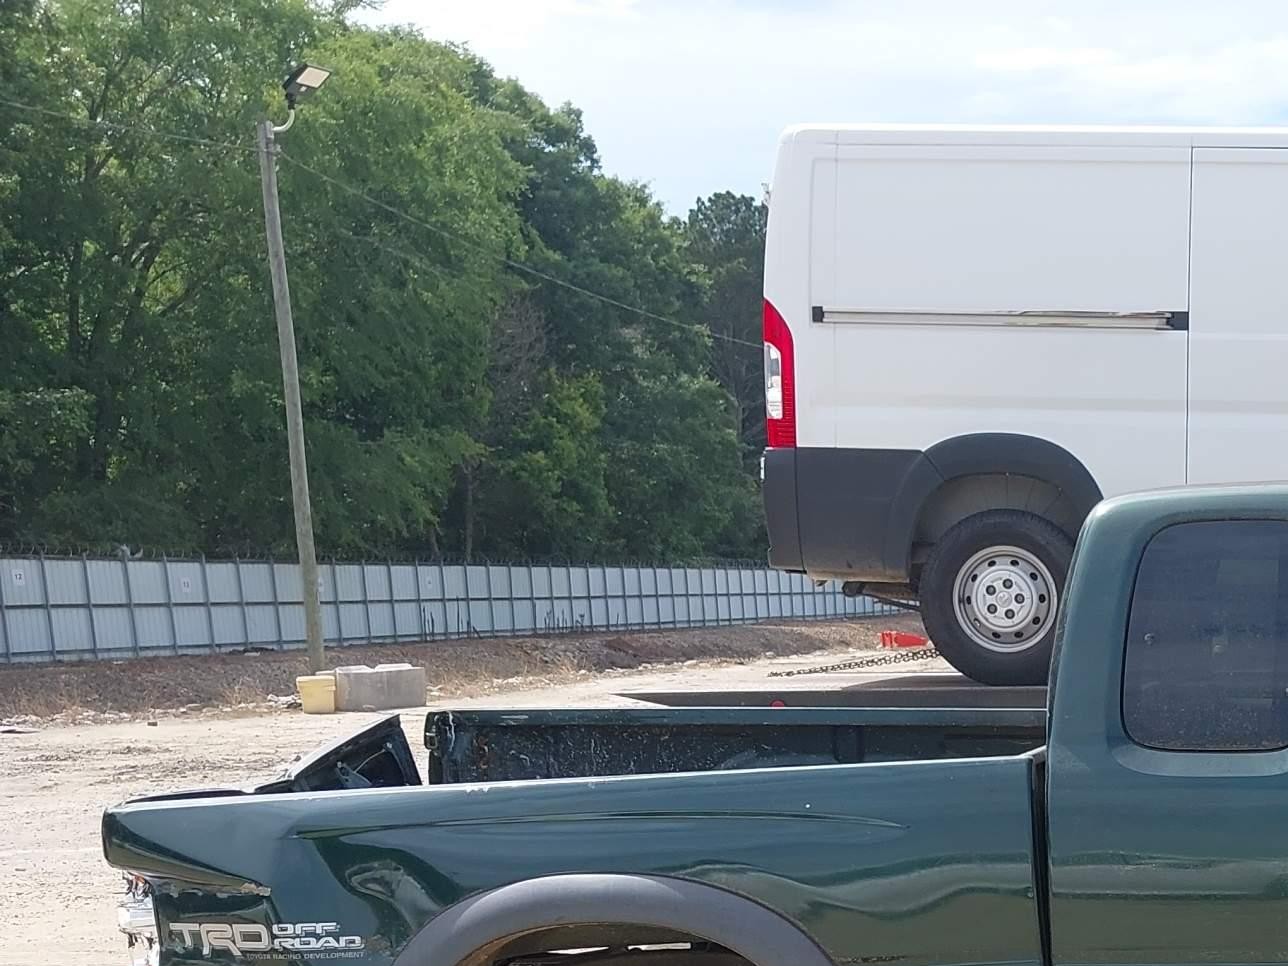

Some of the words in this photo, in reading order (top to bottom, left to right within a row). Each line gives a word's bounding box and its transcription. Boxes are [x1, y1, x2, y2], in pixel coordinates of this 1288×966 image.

[169, 922, 271, 957] TRD
[271, 922, 339, 936] OFF
[272, 935, 365, 950] ROAD
[246, 952, 271, 961] TOYOTA
[272, 952, 302, 960] RACING
[303, 951, 365, 960] DEVELOPMENT
